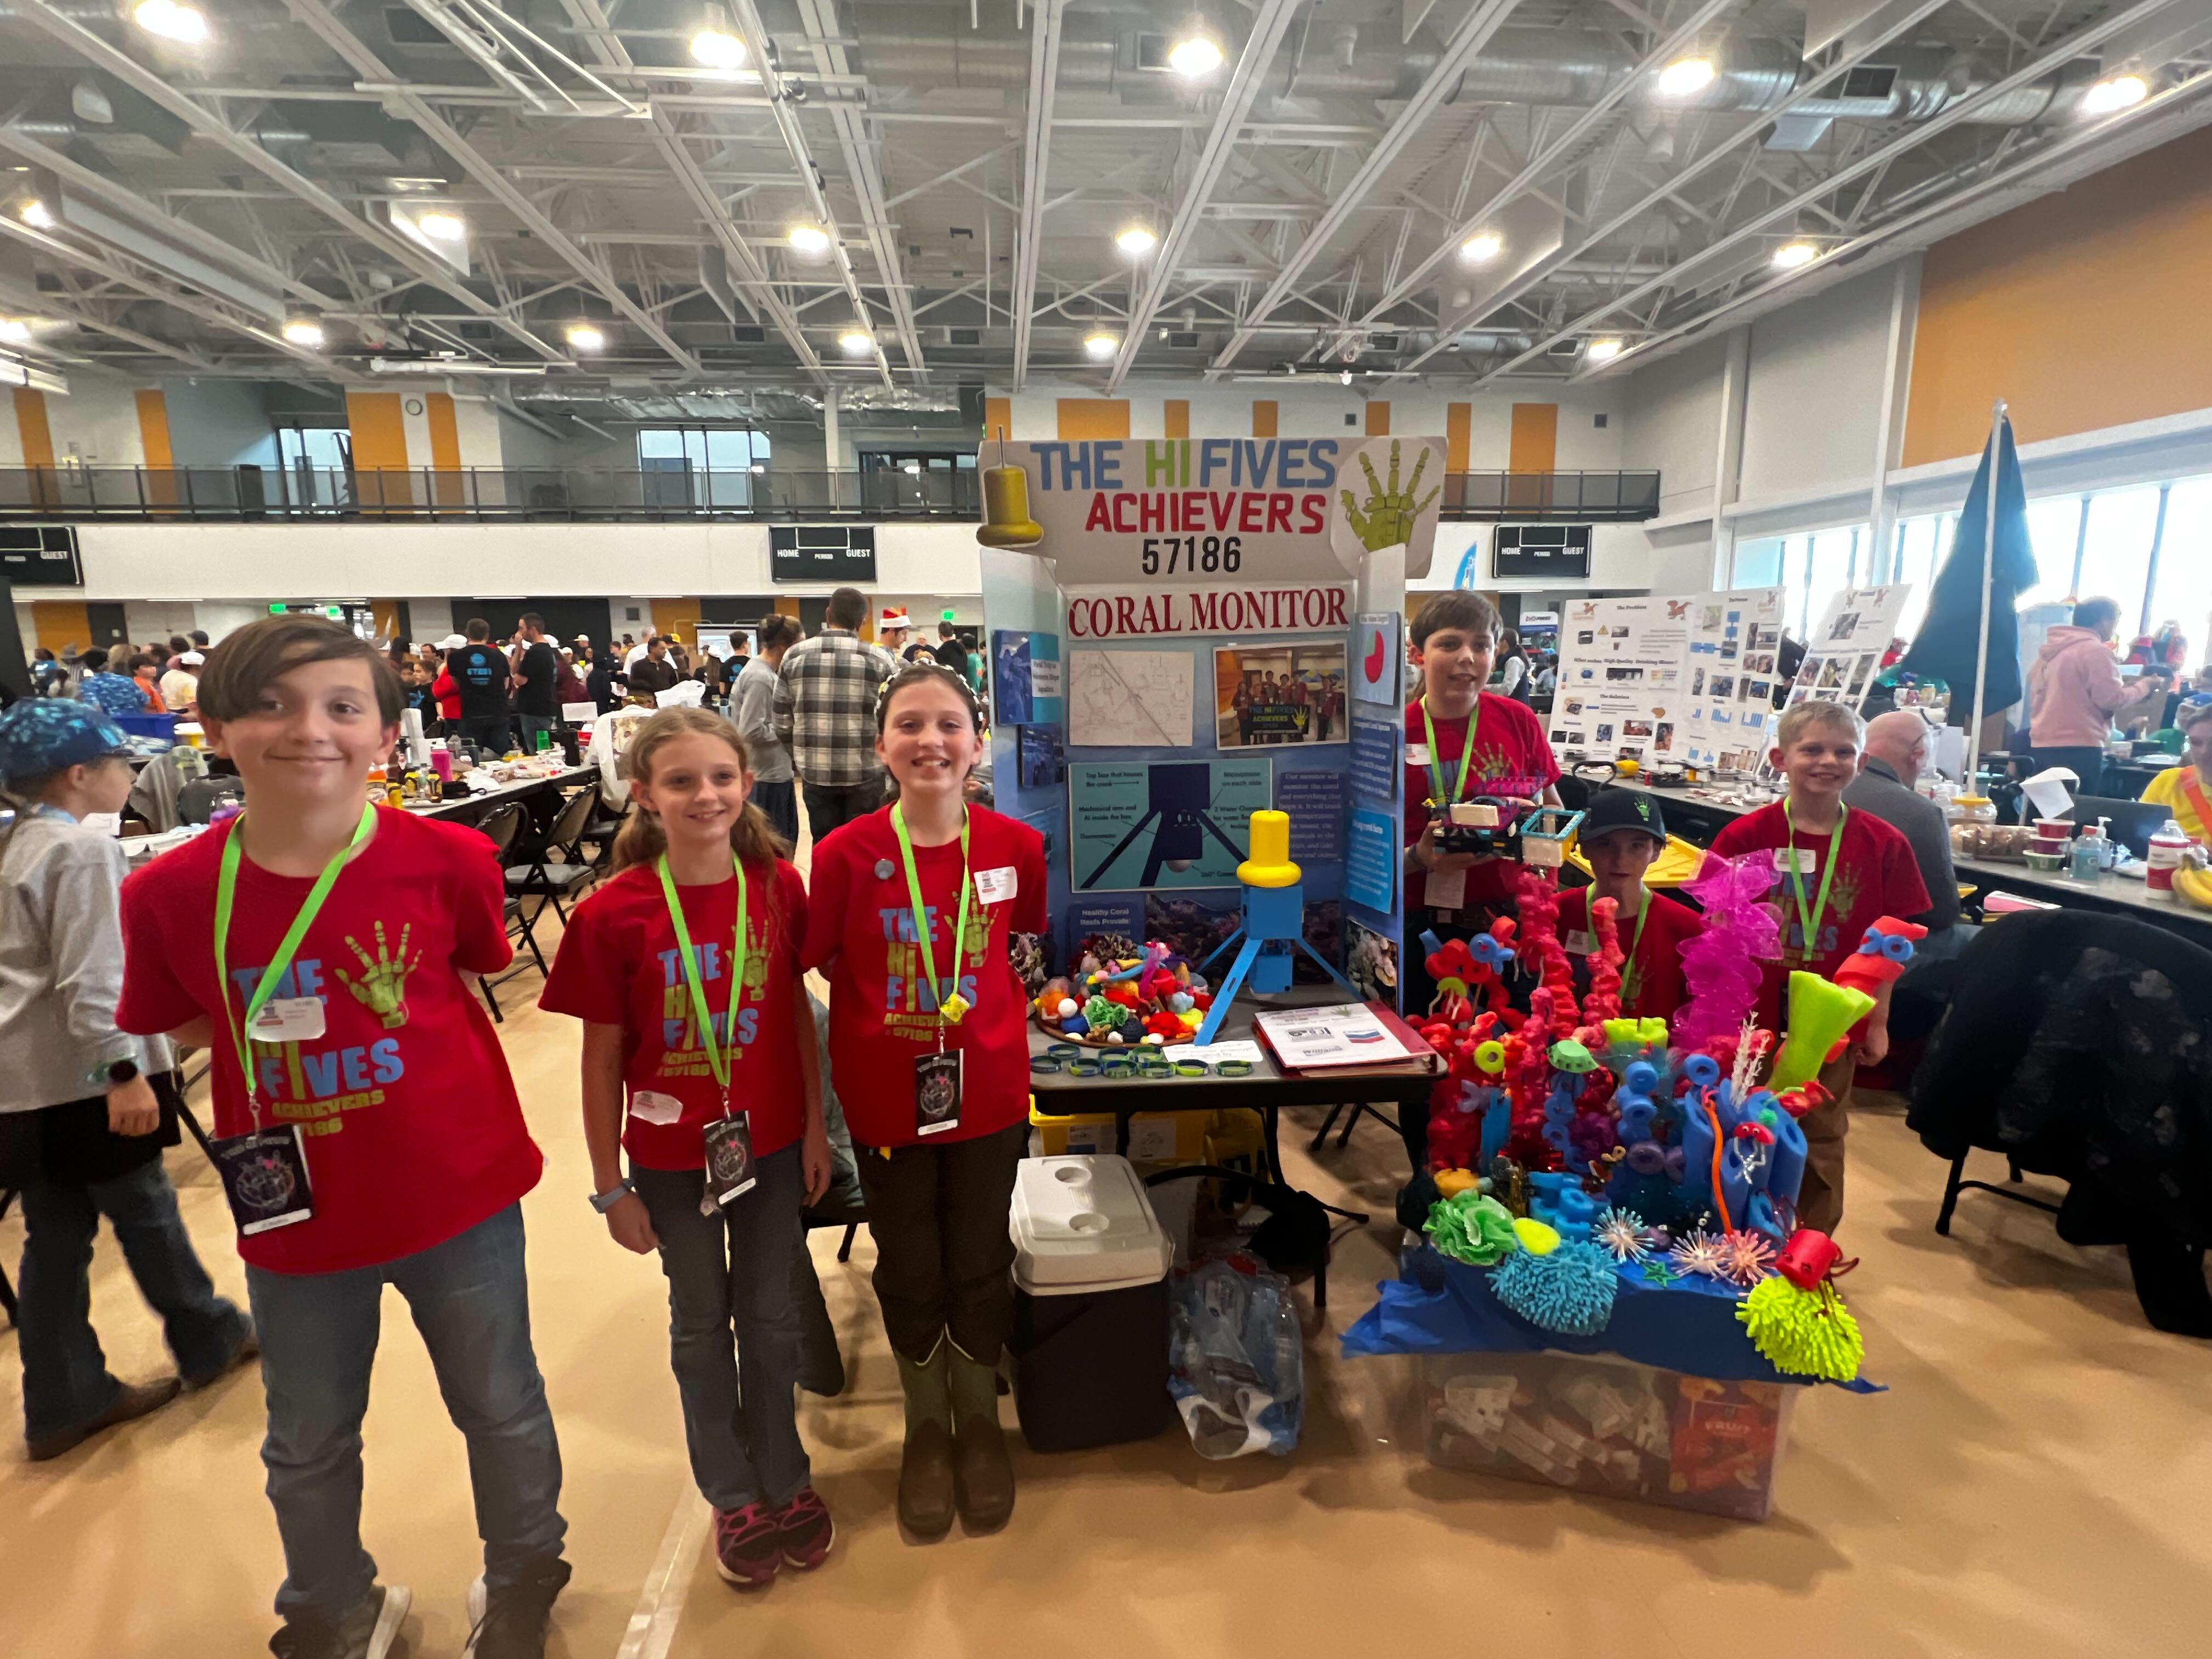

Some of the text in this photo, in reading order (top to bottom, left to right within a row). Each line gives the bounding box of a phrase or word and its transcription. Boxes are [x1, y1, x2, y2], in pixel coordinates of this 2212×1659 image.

[1030, 439, 1339, 490] THE HI FIVES
[1085, 492, 1327, 534] ACHIEVERS
[41, 551, 67, 560] GUEST
[777, 549, 799, 557] HOME
[846, 549, 871, 557] GUEST
[1142, 537, 1242, 575] 57186
[1562, 547, 1584, 555] GUEST
[1069, 588, 1348, 637] CORAL MONITOR
[879, 906, 939, 943] THE
[259, 1037, 404, 1100] FIVES
